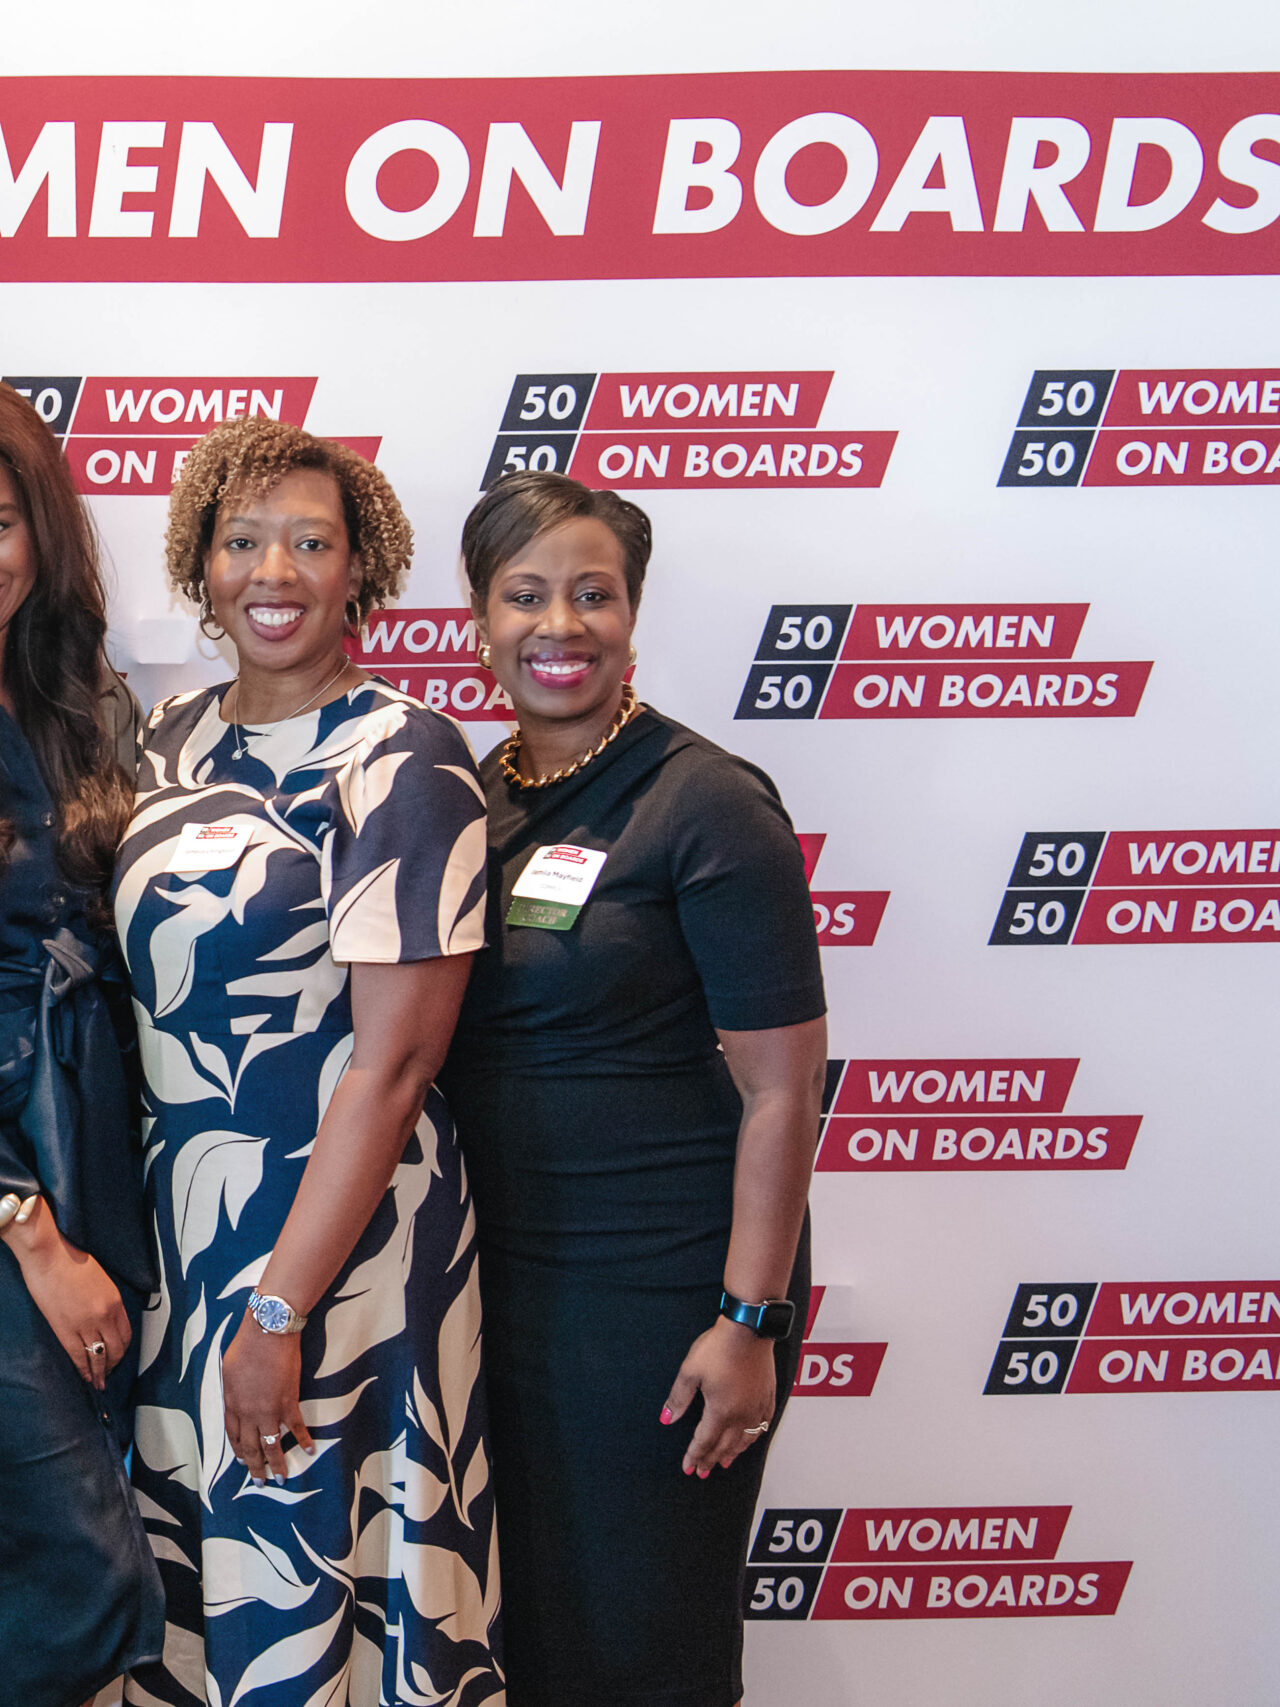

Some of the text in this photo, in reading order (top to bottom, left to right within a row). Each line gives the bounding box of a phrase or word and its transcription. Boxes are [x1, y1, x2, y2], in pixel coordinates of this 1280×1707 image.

[345, 120, 601, 241] ON
[653, 112, 1280, 235] BOARDS
[16, 387, 283, 423] 0 WOMEN
[520, 384, 799, 420] 50 WOMEN
[1038, 381, 1094, 416] 50
[86, 450, 156, 484] ON
[501, 443, 863, 479] 50 ON BOARDS
[1018, 442, 1074, 476] 50
[1117, 442, 1188, 475] ON
[361, 620, 481, 654] WOM
[776, 615, 1054, 650] 50 WOMEN
[424, 677, 515, 712] BOA
[755, 674, 1118, 709] 50 ON BOARDS
[1029, 843, 1085, 876] 50
[1009, 901, 1065, 934] 50
[1107, 901, 1177, 934] ON
[869, 1070, 1045, 1103] WOMEN
[848, 1127, 1108, 1161] ON BOARDS
[1023, 1294, 1077, 1327] 50
[1004, 1348, 1280, 1384] 50 ON BOA
[769, 1518, 1038, 1552] 50 WOMEN
[750, 1573, 1099, 1610] 50 ON BOARDS
